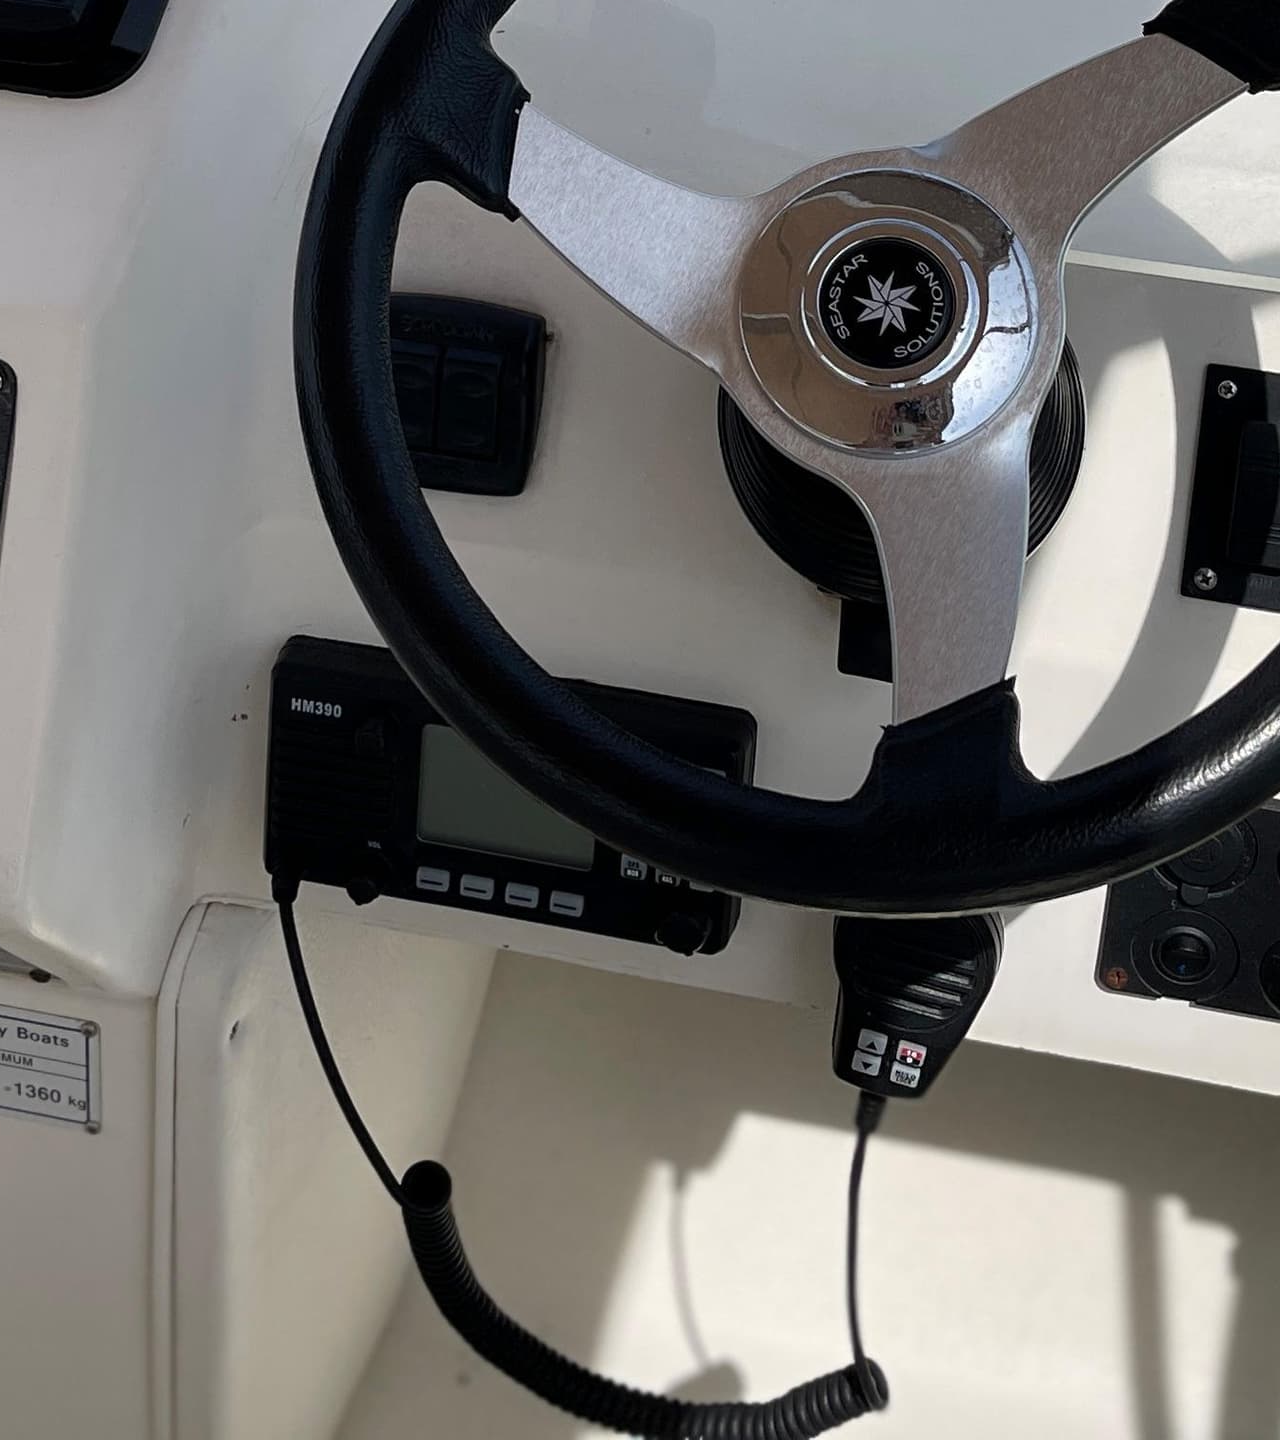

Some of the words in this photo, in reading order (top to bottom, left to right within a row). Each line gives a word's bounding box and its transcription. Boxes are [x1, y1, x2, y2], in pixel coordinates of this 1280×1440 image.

[828, 254, 869, 340] SEASTAR
[893, 261, 944, 358] SOLUTIONS
[291, 697, 343, 718] HM390
[17, 1026, 70, 1048] Boats
[68, 1095, 87, 1111] kg
